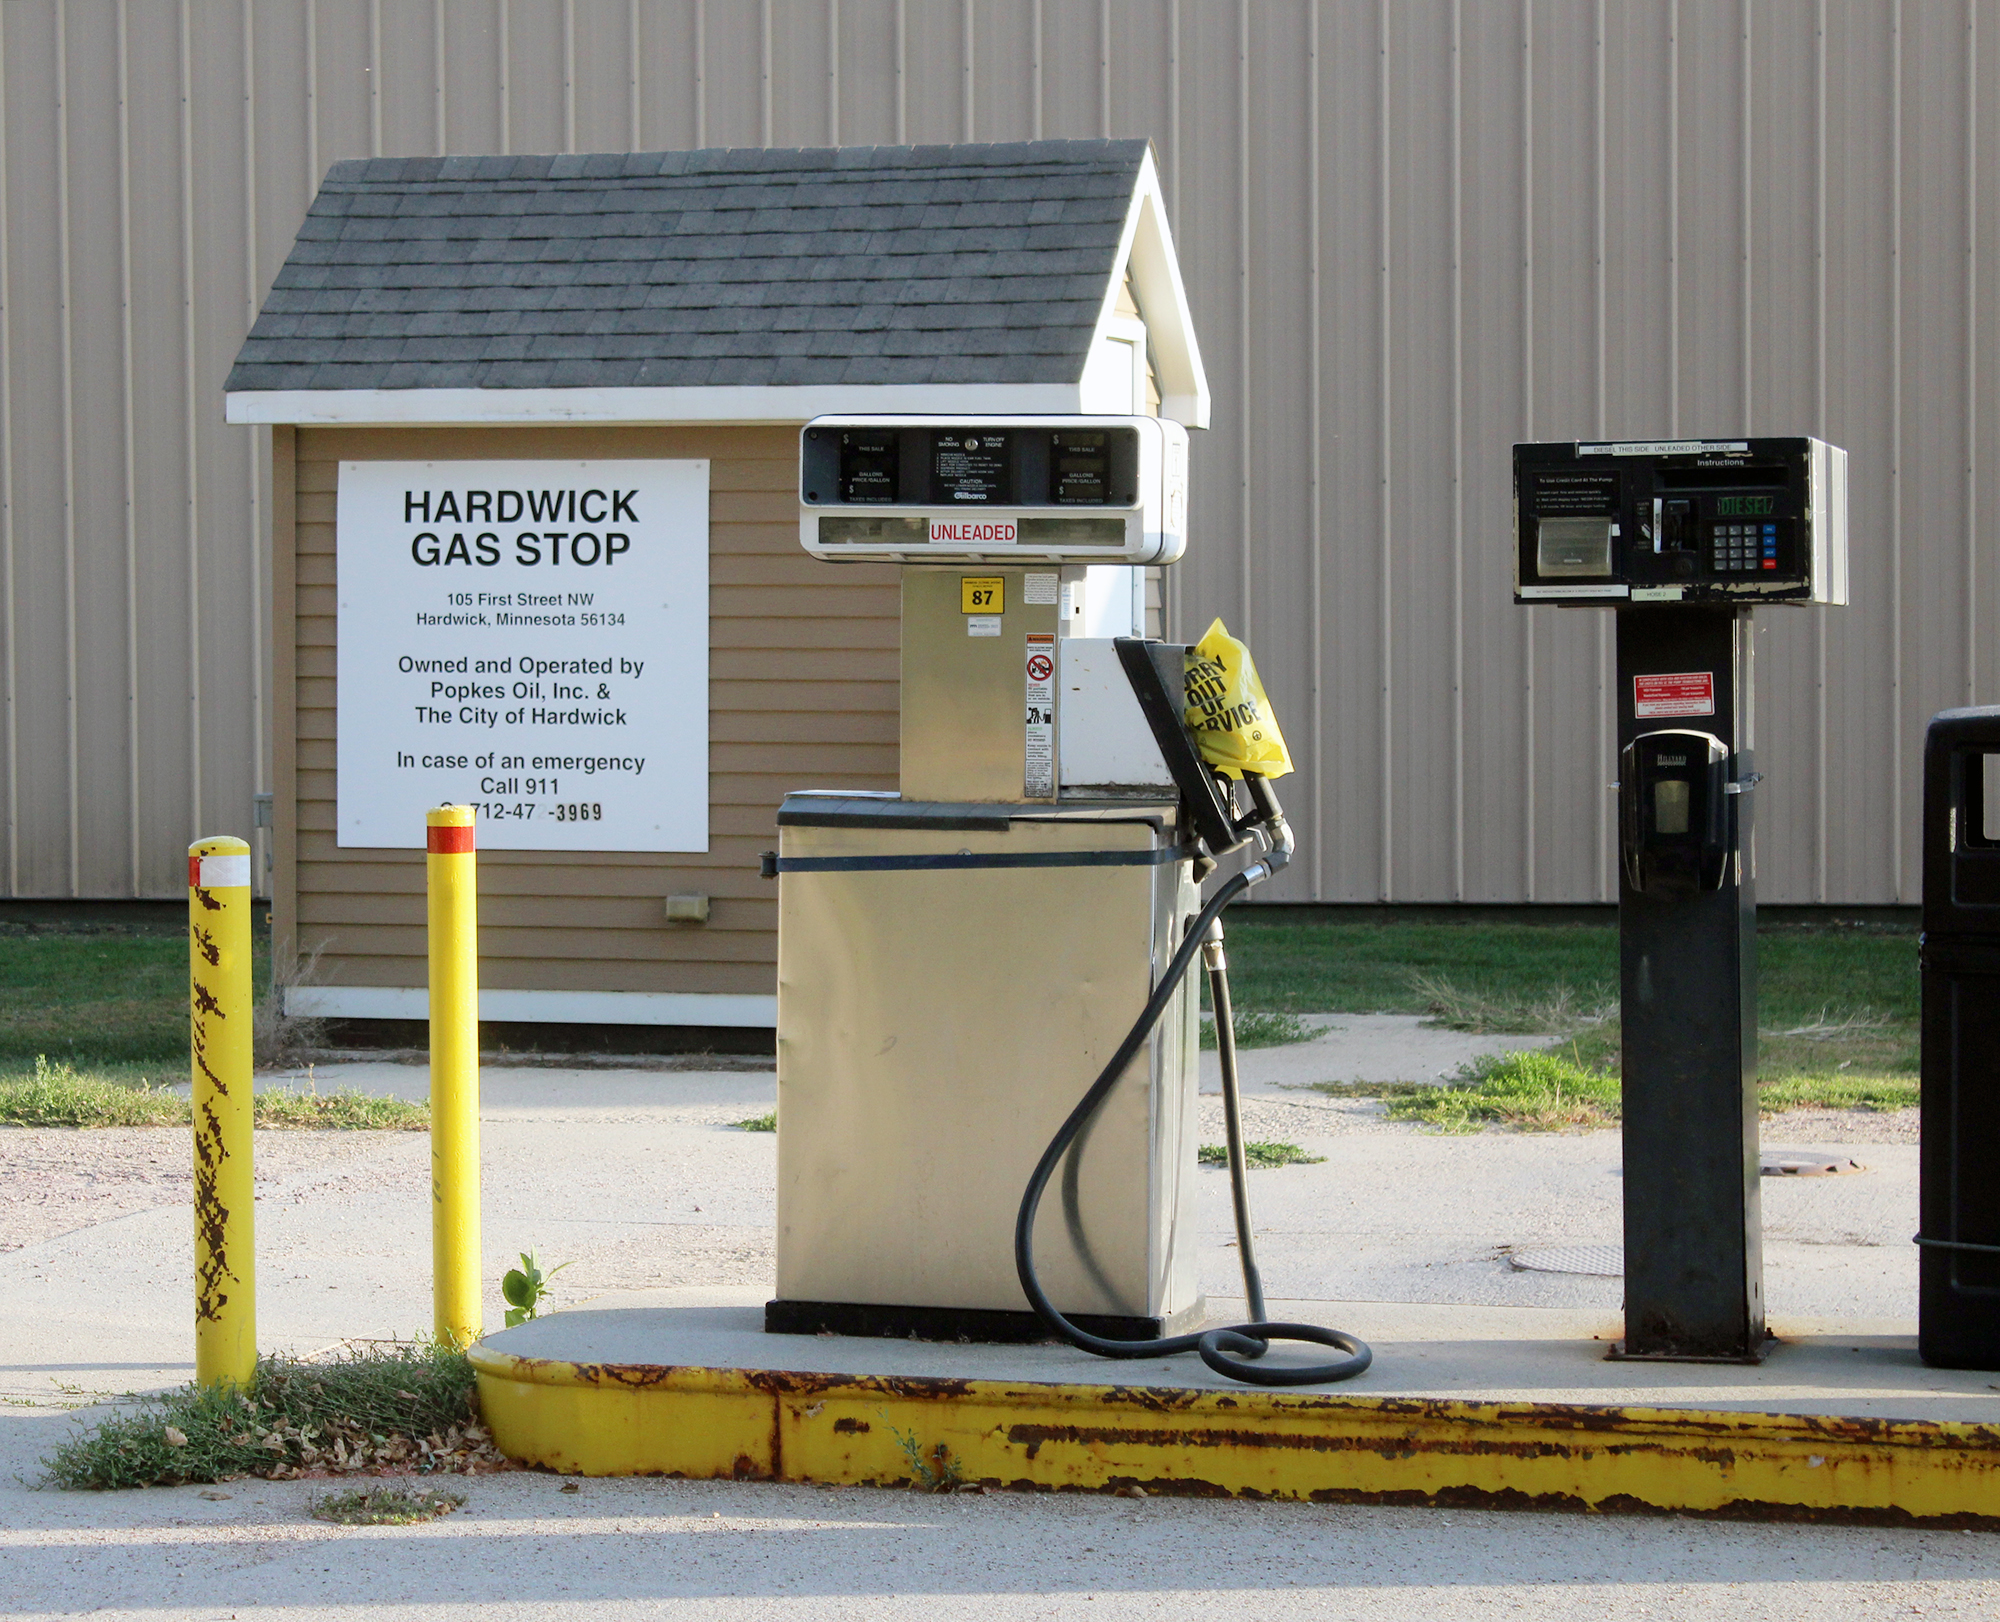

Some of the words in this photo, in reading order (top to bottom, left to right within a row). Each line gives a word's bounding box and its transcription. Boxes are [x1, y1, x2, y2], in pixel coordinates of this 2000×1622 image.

[844, 434, 849, 444] $
[1053, 434, 1059, 445] $
[1634, 445, 1650, 453] SIDE
[1698, 458, 1744, 466] Instructions
[849, 485, 854, 494] $
[1059, 486, 1064, 495] $
[405, 490, 639, 523] HARDWICK
[1721, 498, 1771, 515] DIESEL
[931, 525, 1015, 541] UNLEADED
[412, 533, 500, 566] GAS
[516, 532, 630, 566] STOP
[448, 594, 472, 605] 105
[479, 594, 511, 606] First
[518, 593, 562, 606] Street
[568, 594, 594, 605] NW
[972, 591, 993, 605] 87
[417, 613, 491, 628] Hardwick,
[497, 613, 575, 625] Minnesota
[581, 613, 624, 626] 56134
[399, 656, 467, 673] Owned
[475, 657, 511, 673] and
[520, 657, 612, 678] Operated
[621, 658, 644, 678] by
[432, 682, 505, 702] Popkes
[513, 682, 546, 703] Oil,
[554, 683, 588, 699] Inc.
[597, 683, 609, 699] &
[1187, 676, 1227, 707] OUT
[416, 707, 451, 723] The
[460, 707, 498, 728] City
[506, 708, 524, 724] of
[533, 708, 626, 725] Hardwick
[398, 752, 414, 767] In
[422, 756, 468, 768] case
[476, 752, 494, 768] of
[502, 757, 524, 769] an
[532, 757, 645, 774] emergency
[481, 777, 517, 794] Call
[526, 778, 557, 794] 911
